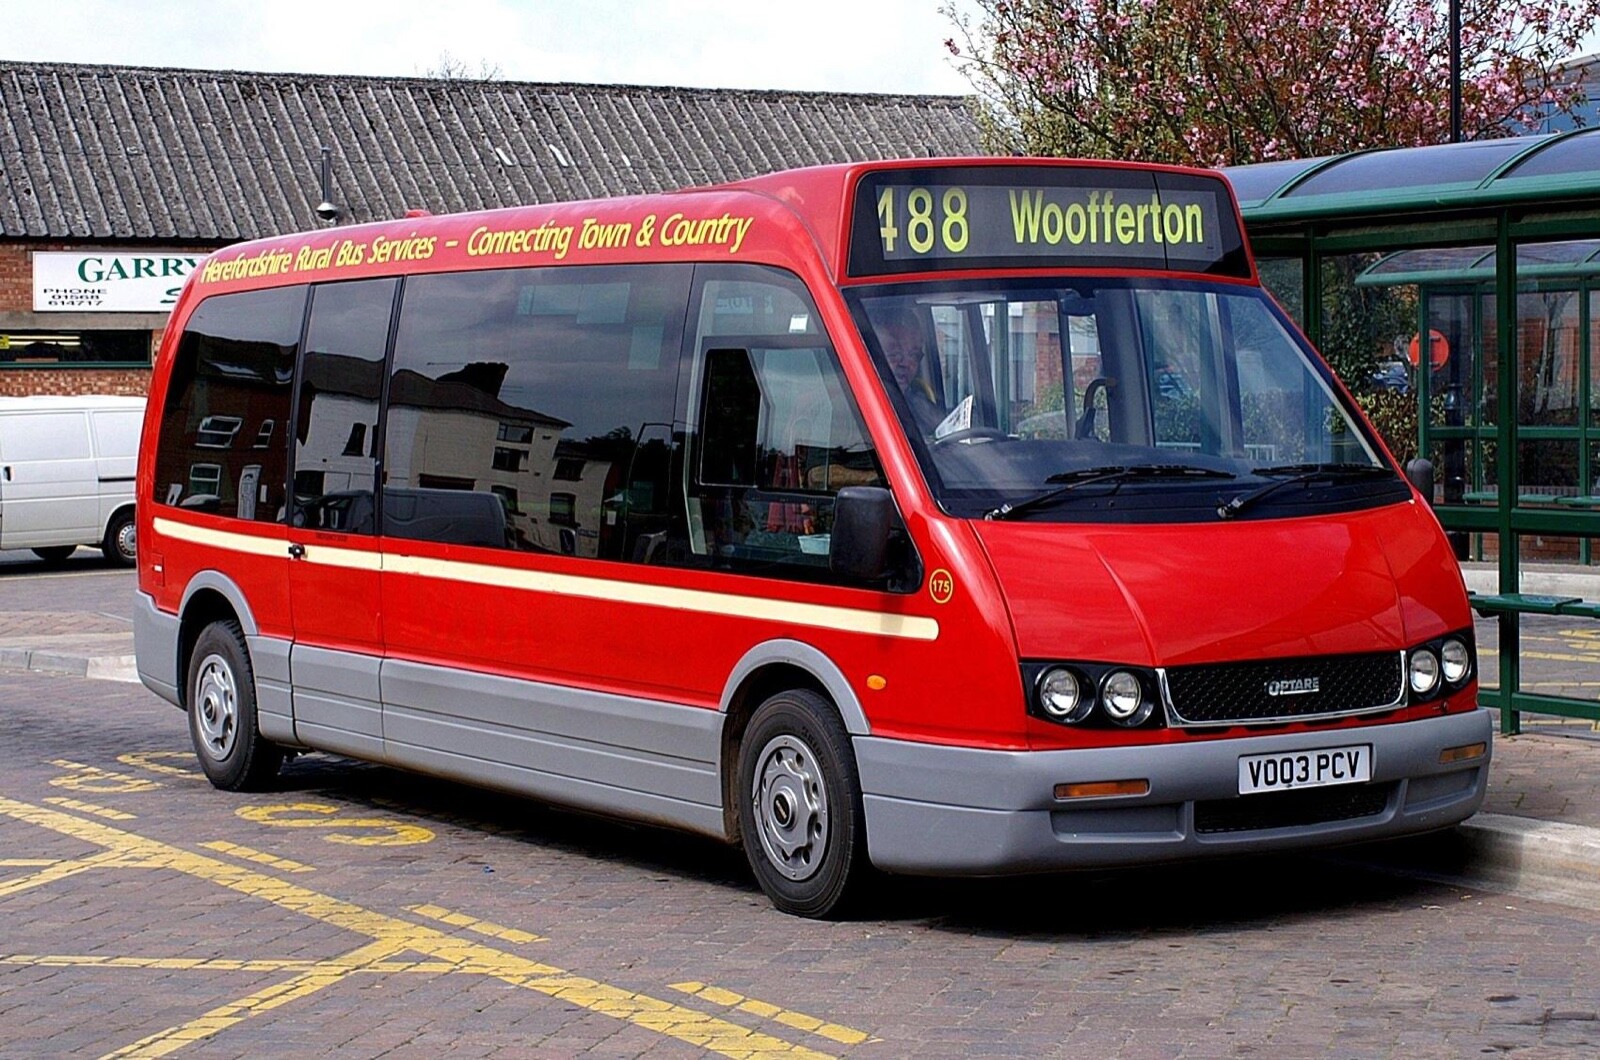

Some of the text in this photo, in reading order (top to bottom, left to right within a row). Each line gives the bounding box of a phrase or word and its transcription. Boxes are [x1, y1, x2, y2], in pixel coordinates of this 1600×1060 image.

[877, 186, 1204, 254] 488 Woofferton
[201, 248, 292, 284] Herefordshire
[293, 239, 336, 272] Rural
[335, 240, 367, 267] Bus
[367, 231, 437, 265] Services
[467, 219, 574, 260] Connecting
[577, 217, 632, 250] Town
[635, 213, 657, 247] &
[659, 212, 754, 254] Country
[932, 578, 950, 593] 175
[1268, 676, 1319, 697] OPTARE
[1316, 750, 1360, 781] PCV
